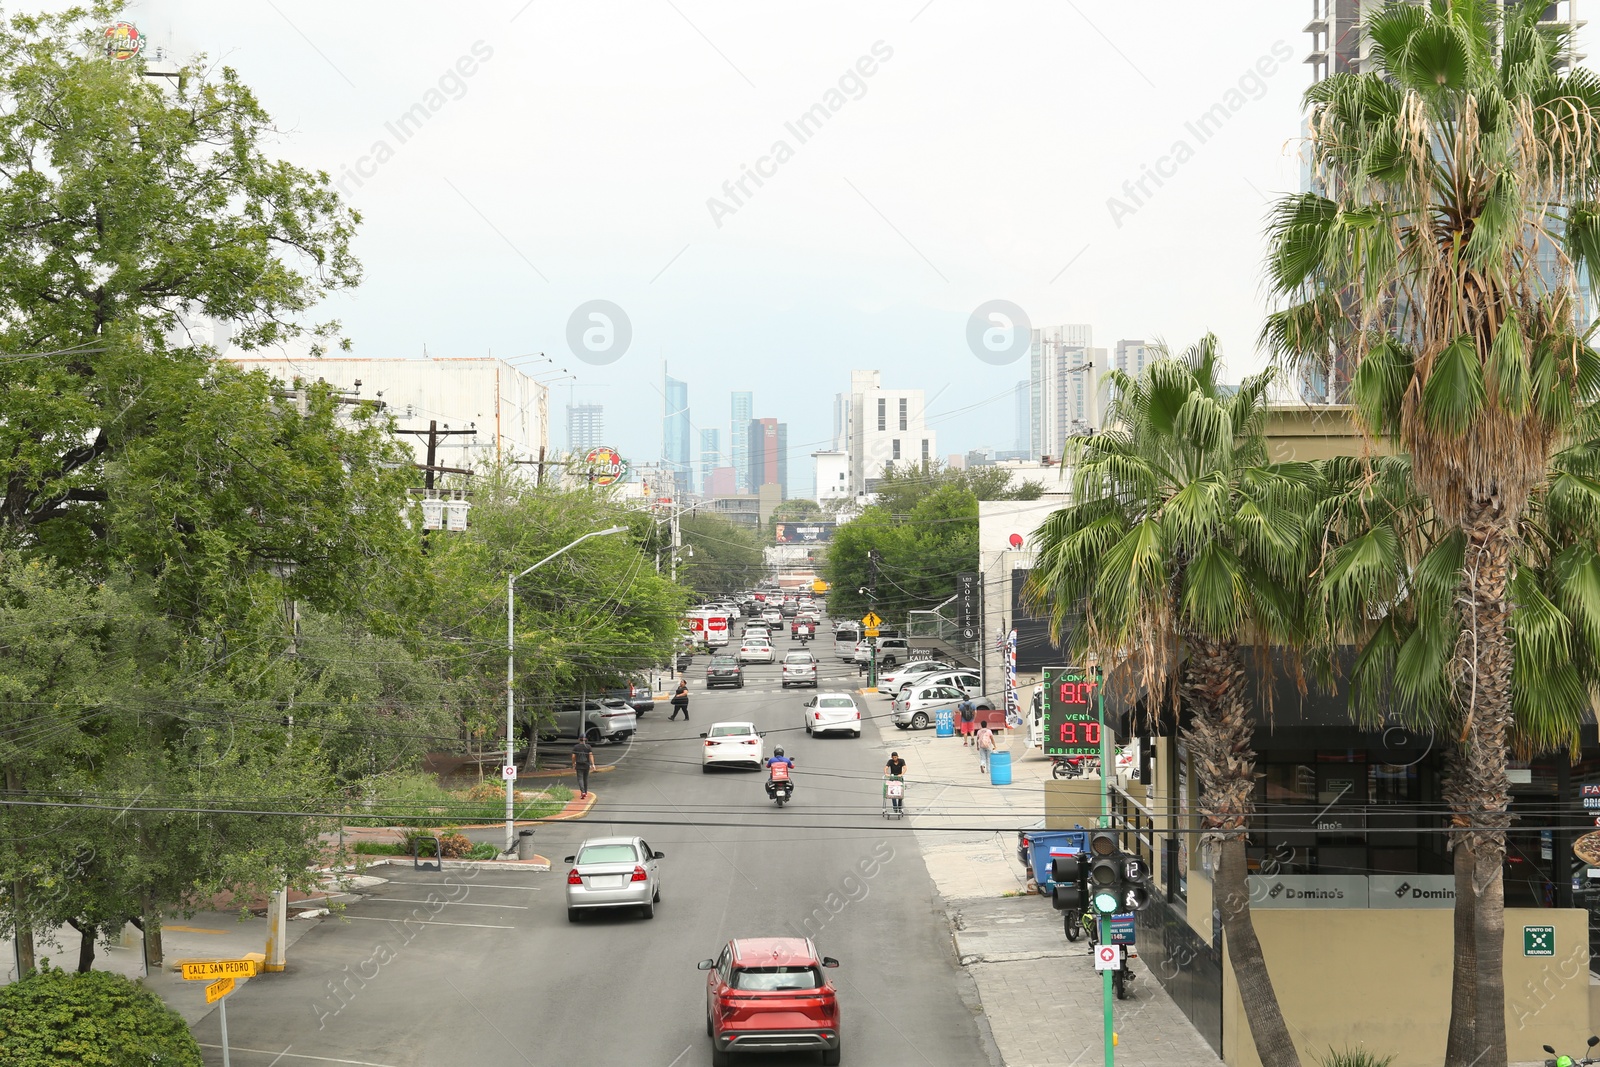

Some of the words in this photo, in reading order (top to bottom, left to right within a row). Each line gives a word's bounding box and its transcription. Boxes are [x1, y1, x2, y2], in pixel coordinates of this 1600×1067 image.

[1584, 785, 1600, 794] FA
[1126, 862, 1138, 878] 12
[1286, 888, 1344, 899] Domino's
[1412, 888, 1457, 899] Domin
[209, 963, 224, 973] SAN
[225, 962, 249, 972] PEDRO
